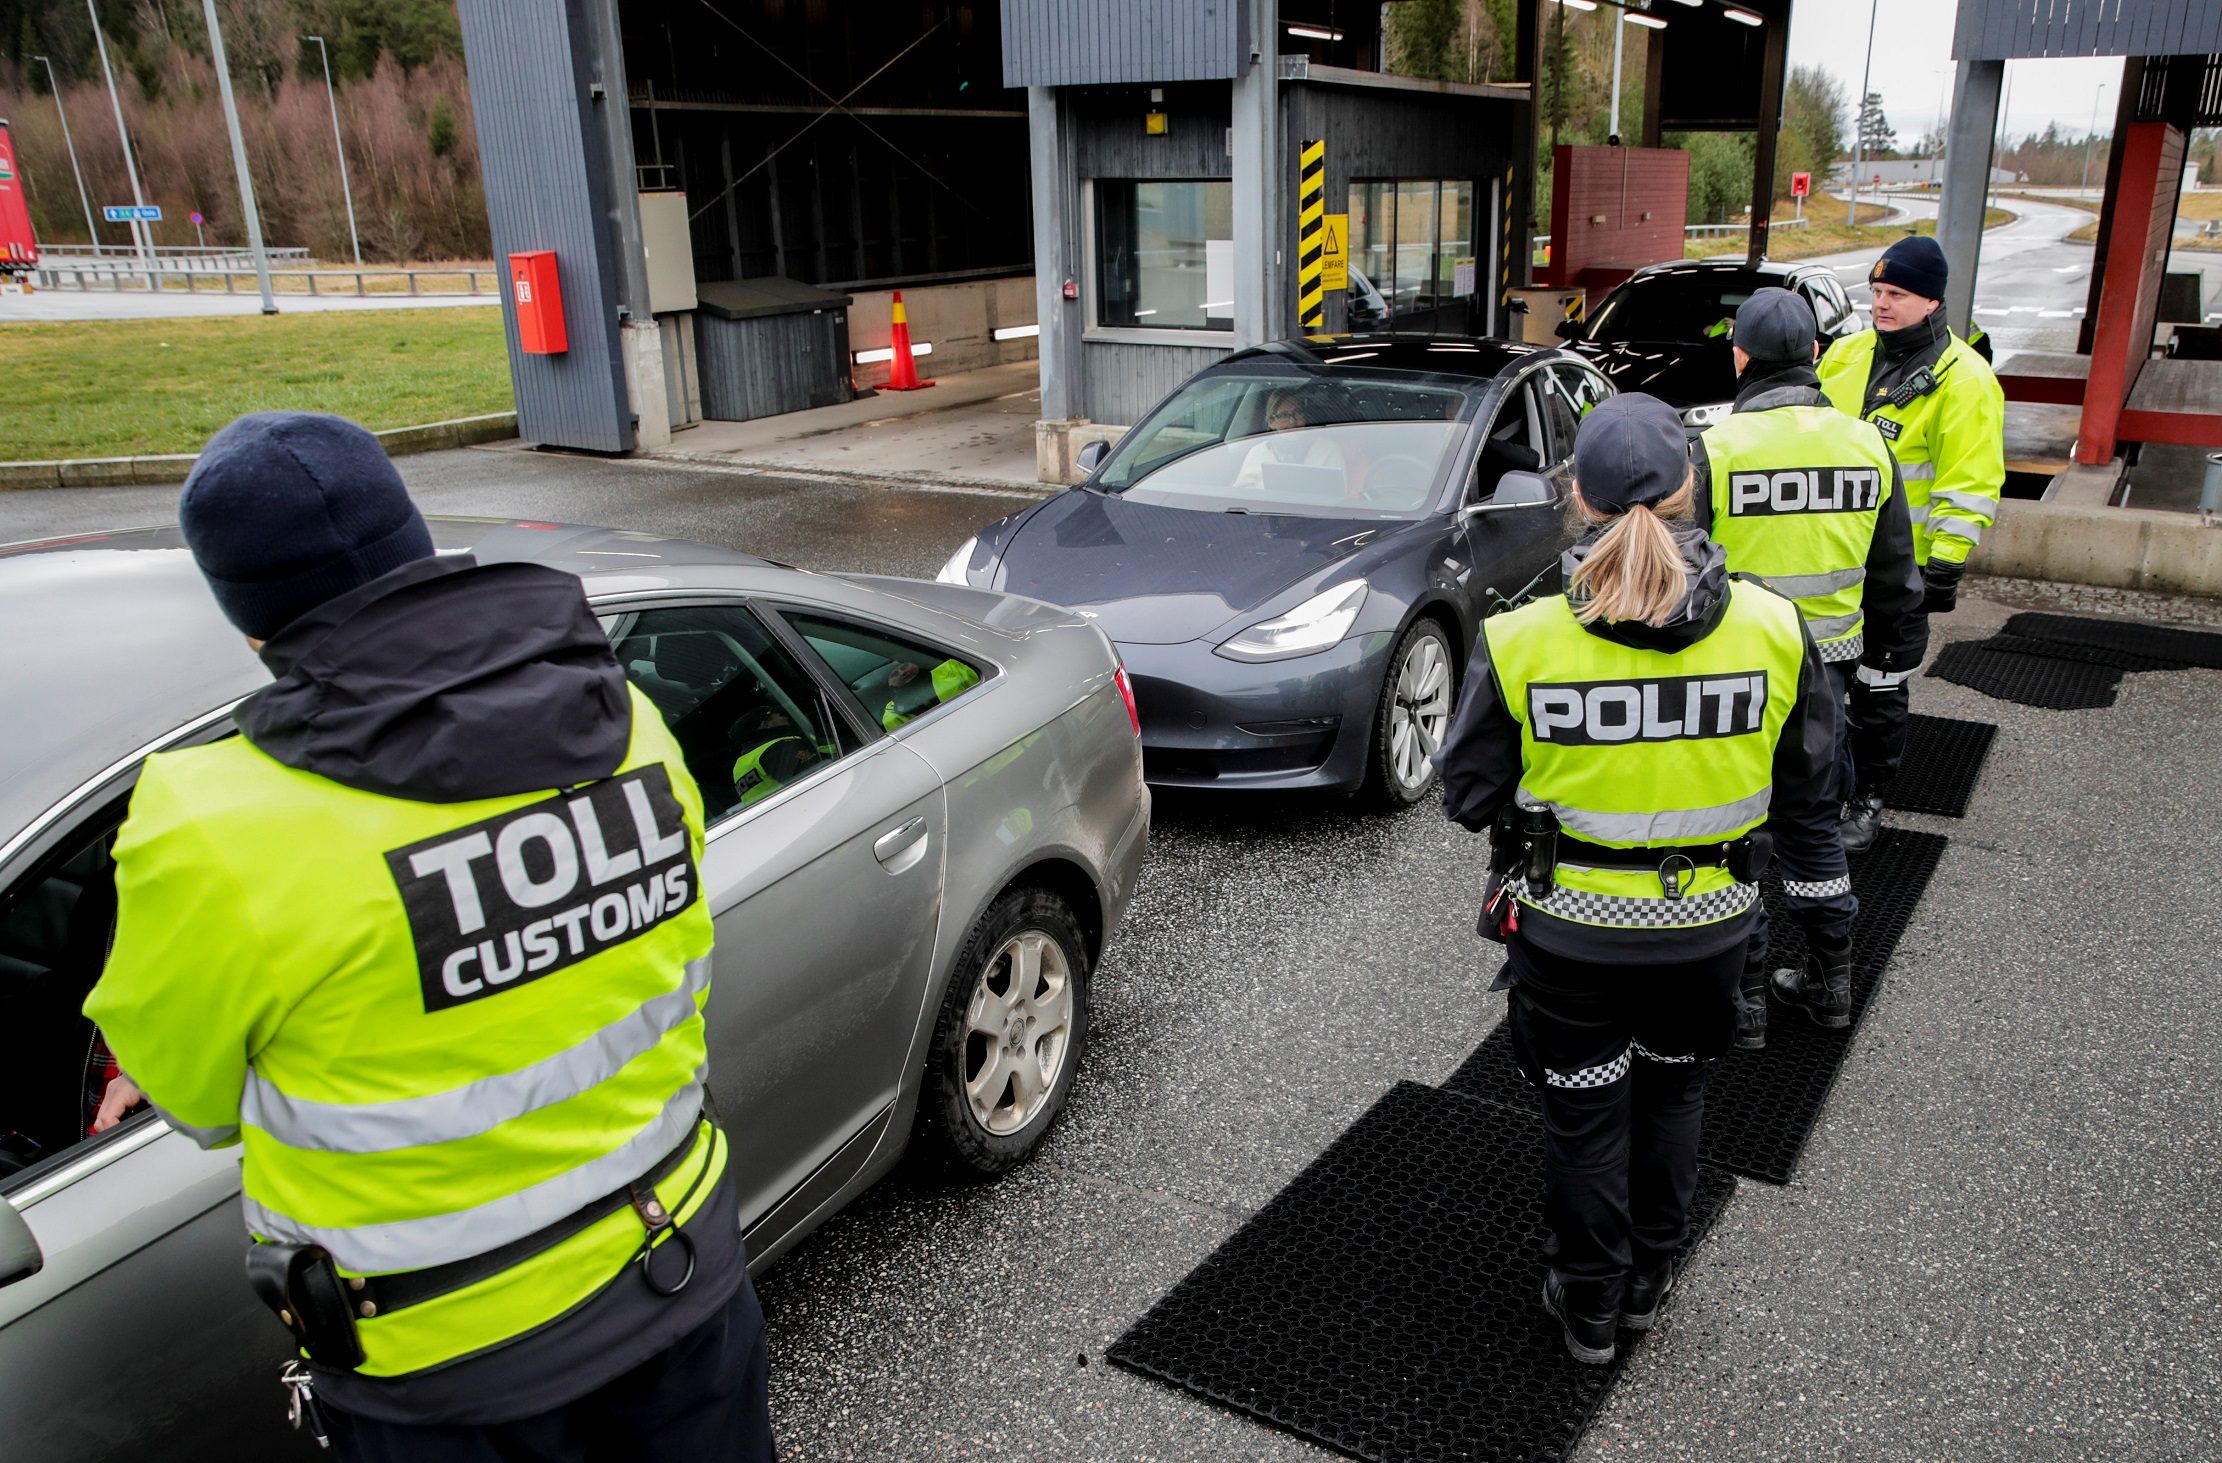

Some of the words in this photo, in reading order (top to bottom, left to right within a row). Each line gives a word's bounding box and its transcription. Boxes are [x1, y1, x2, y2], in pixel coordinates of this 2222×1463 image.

[1322, 259, 1344, 270] LEMFARE
[1876, 417, 1898, 433] TOLL
[1732, 470, 1880, 514] POLITI
[1531, 675, 1764, 741] POLITI
[409, 778, 685, 936] TOLL
[442, 863, 689, 997] CUSTOMS
